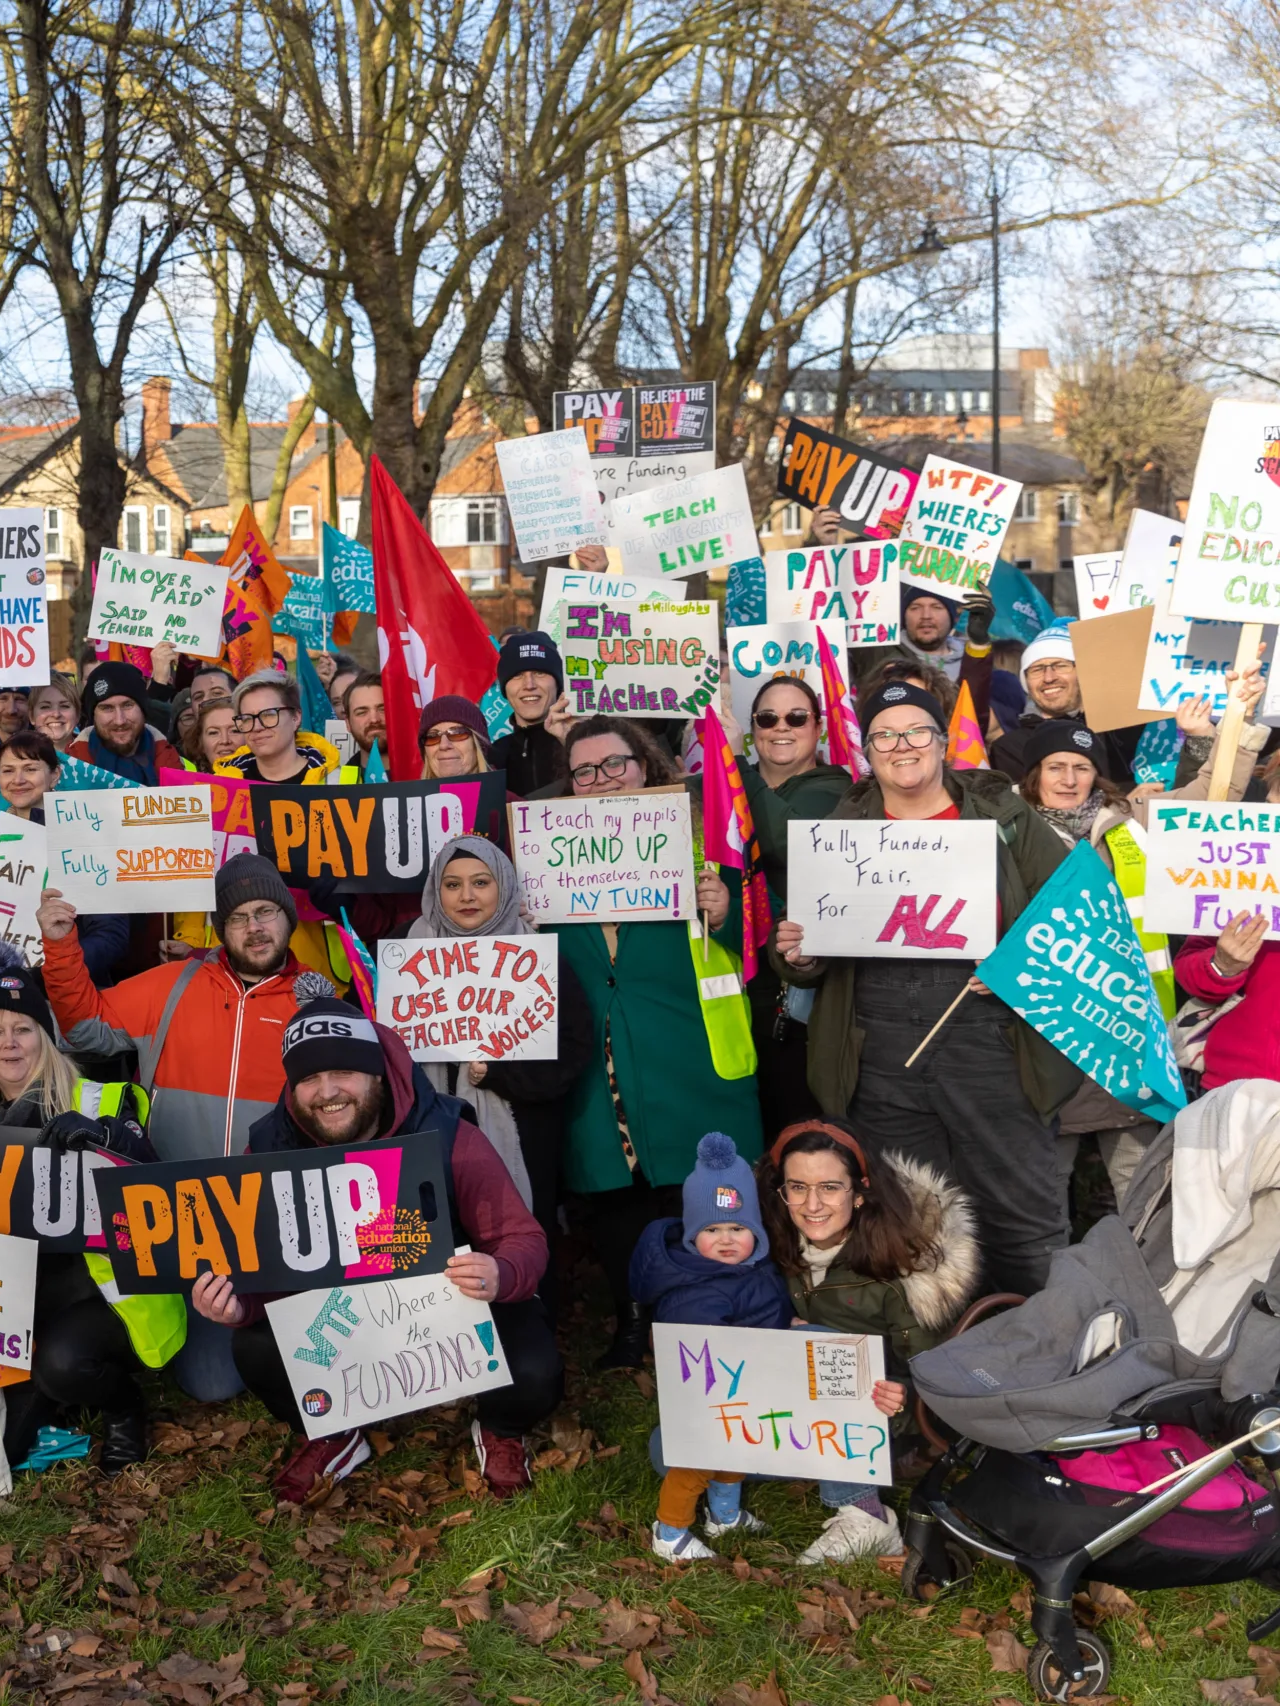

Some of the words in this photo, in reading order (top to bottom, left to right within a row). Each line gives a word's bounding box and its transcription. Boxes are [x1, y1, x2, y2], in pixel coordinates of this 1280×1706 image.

[564, 392, 622, 418] PAY
[640, 390, 681, 404] REJECT
[686, 387, 706, 401] THE
[641, 403, 674, 420] PAY
[627, 460, 687, 481] funding
[784, 431, 858, 506] PAY
[927, 468, 1007, 506] WTF!
[643, 497, 716, 528] TEACH
[918, 500, 1006, 536] WHERE'S
[1206, 493, 1262, 532] NO
[528, 546, 548, 556] MUST
[555, 542, 569, 550] TRY
[923, 524, 968, 550] THE
[659, 533, 734, 574] LIVE!
[787, 548, 846, 590] PAY
[852, 542, 898, 586] UP
[140, 567, 192, 589] OVER
[562, 575, 637, 598] FUND
[0, 597, 43, 624] HAVE
[100, 601, 147, 620] SAID
[165, 614, 186, 627] NO
[809, 590, 869, 620] PAY
[98, 619, 154, 637] TEACHER
[162, 629, 200, 646] EVER
[567, 603, 631, 639] I'M
[1154, 632, 1185, 648] MY
[566, 655, 608, 680] MY
[569, 678, 681, 713] TEACHER
[55, 800, 103, 831] Fully
[122, 795, 203, 820] FUNDED
[518, 807, 531, 833] I
[541, 805, 593, 831] teach
[604, 815, 621, 838] my
[633, 808, 676, 831] pupils
[270, 797, 375, 878] PAY
[520, 841, 540, 855] to
[547, 836, 623, 867] STAND
[637, 833, 668, 863] UP
[809, 823, 857, 863] Fully
[61, 849, 110, 886] Fully
[116, 847, 214, 874] SUPPORTED
[1197, 841, 1271, 865] JUST
[522, 873, 544, 891] for
[650, 869, 684, 879] now
[1166, 867, 1280, 894] WANNA
[528, 895, 550, 911] it's
[571, 889, 601, 913] MY
[816, 893, 848, 920] For
[876, 894, 968, 950] ALL
[398, 940, 480, 989] TIME
[491, 940, 537, 982] TO
[392, 987, 448, 1023] USE
[458, 985, 515, 1016] OUR
[1071, 993, 1146, 1052] union
[121, 1172, 263, 1279] PAY
[357, 1231, 432, 1244] education
[375, 1222, 412, 1230] national
[293, 1286, 364, 1371] WTF
[405, 1321, 431, 1345] the
[832, 1349, 846, 1359] you
[840, 1358, 856, 1366] this
[341, 1320, 499, 1418] FUNDING!
[678, 1338, 745, 1401] My
[820, 1372, 853, 1380] because
[828, 1387, 856, 1396] teacher
